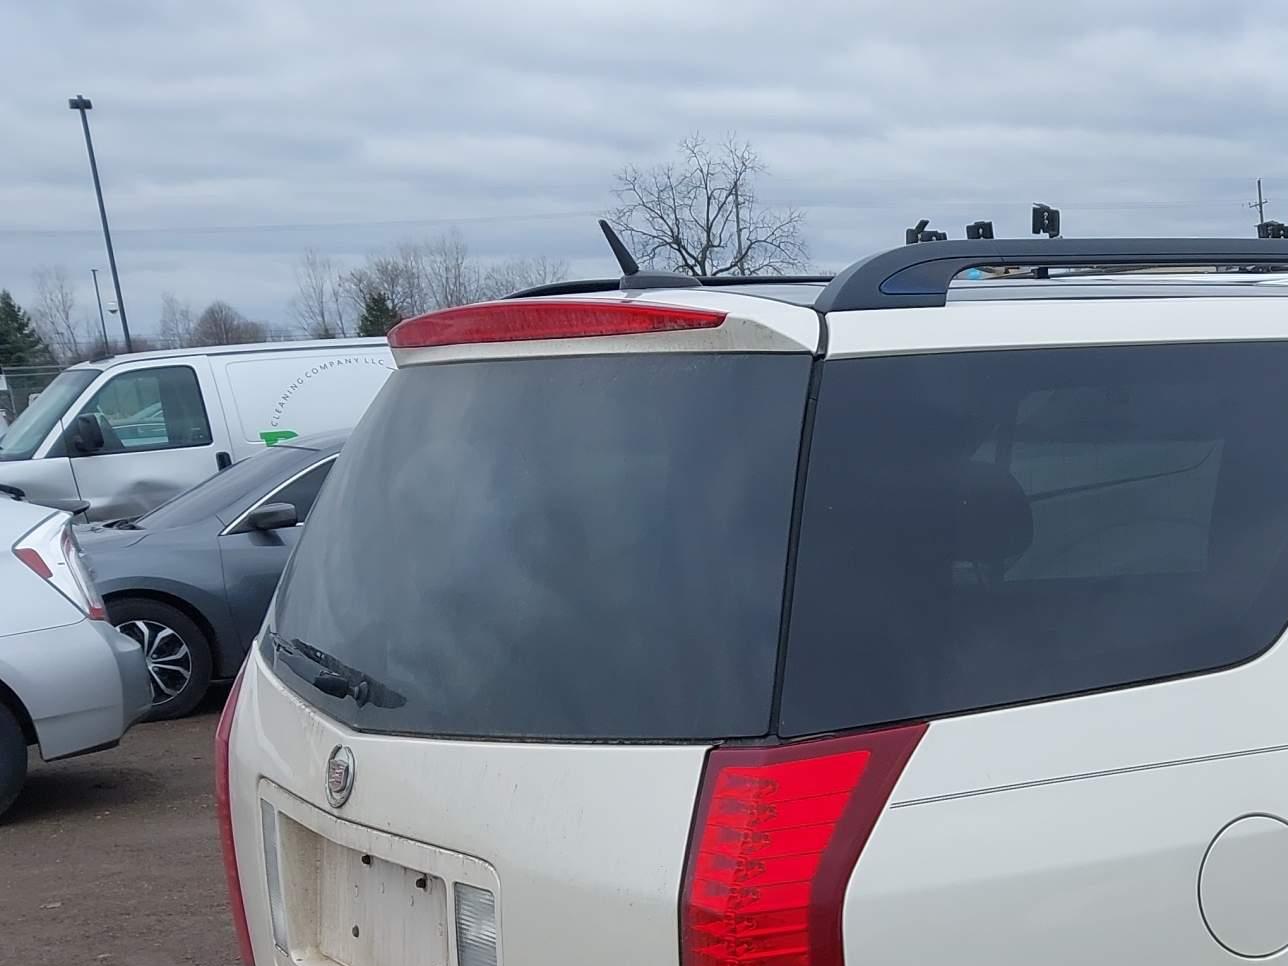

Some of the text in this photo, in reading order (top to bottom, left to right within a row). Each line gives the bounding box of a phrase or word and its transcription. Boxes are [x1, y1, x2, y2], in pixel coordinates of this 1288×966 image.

[271, 358, 384, 428] CLEANING COMPANY LLC
